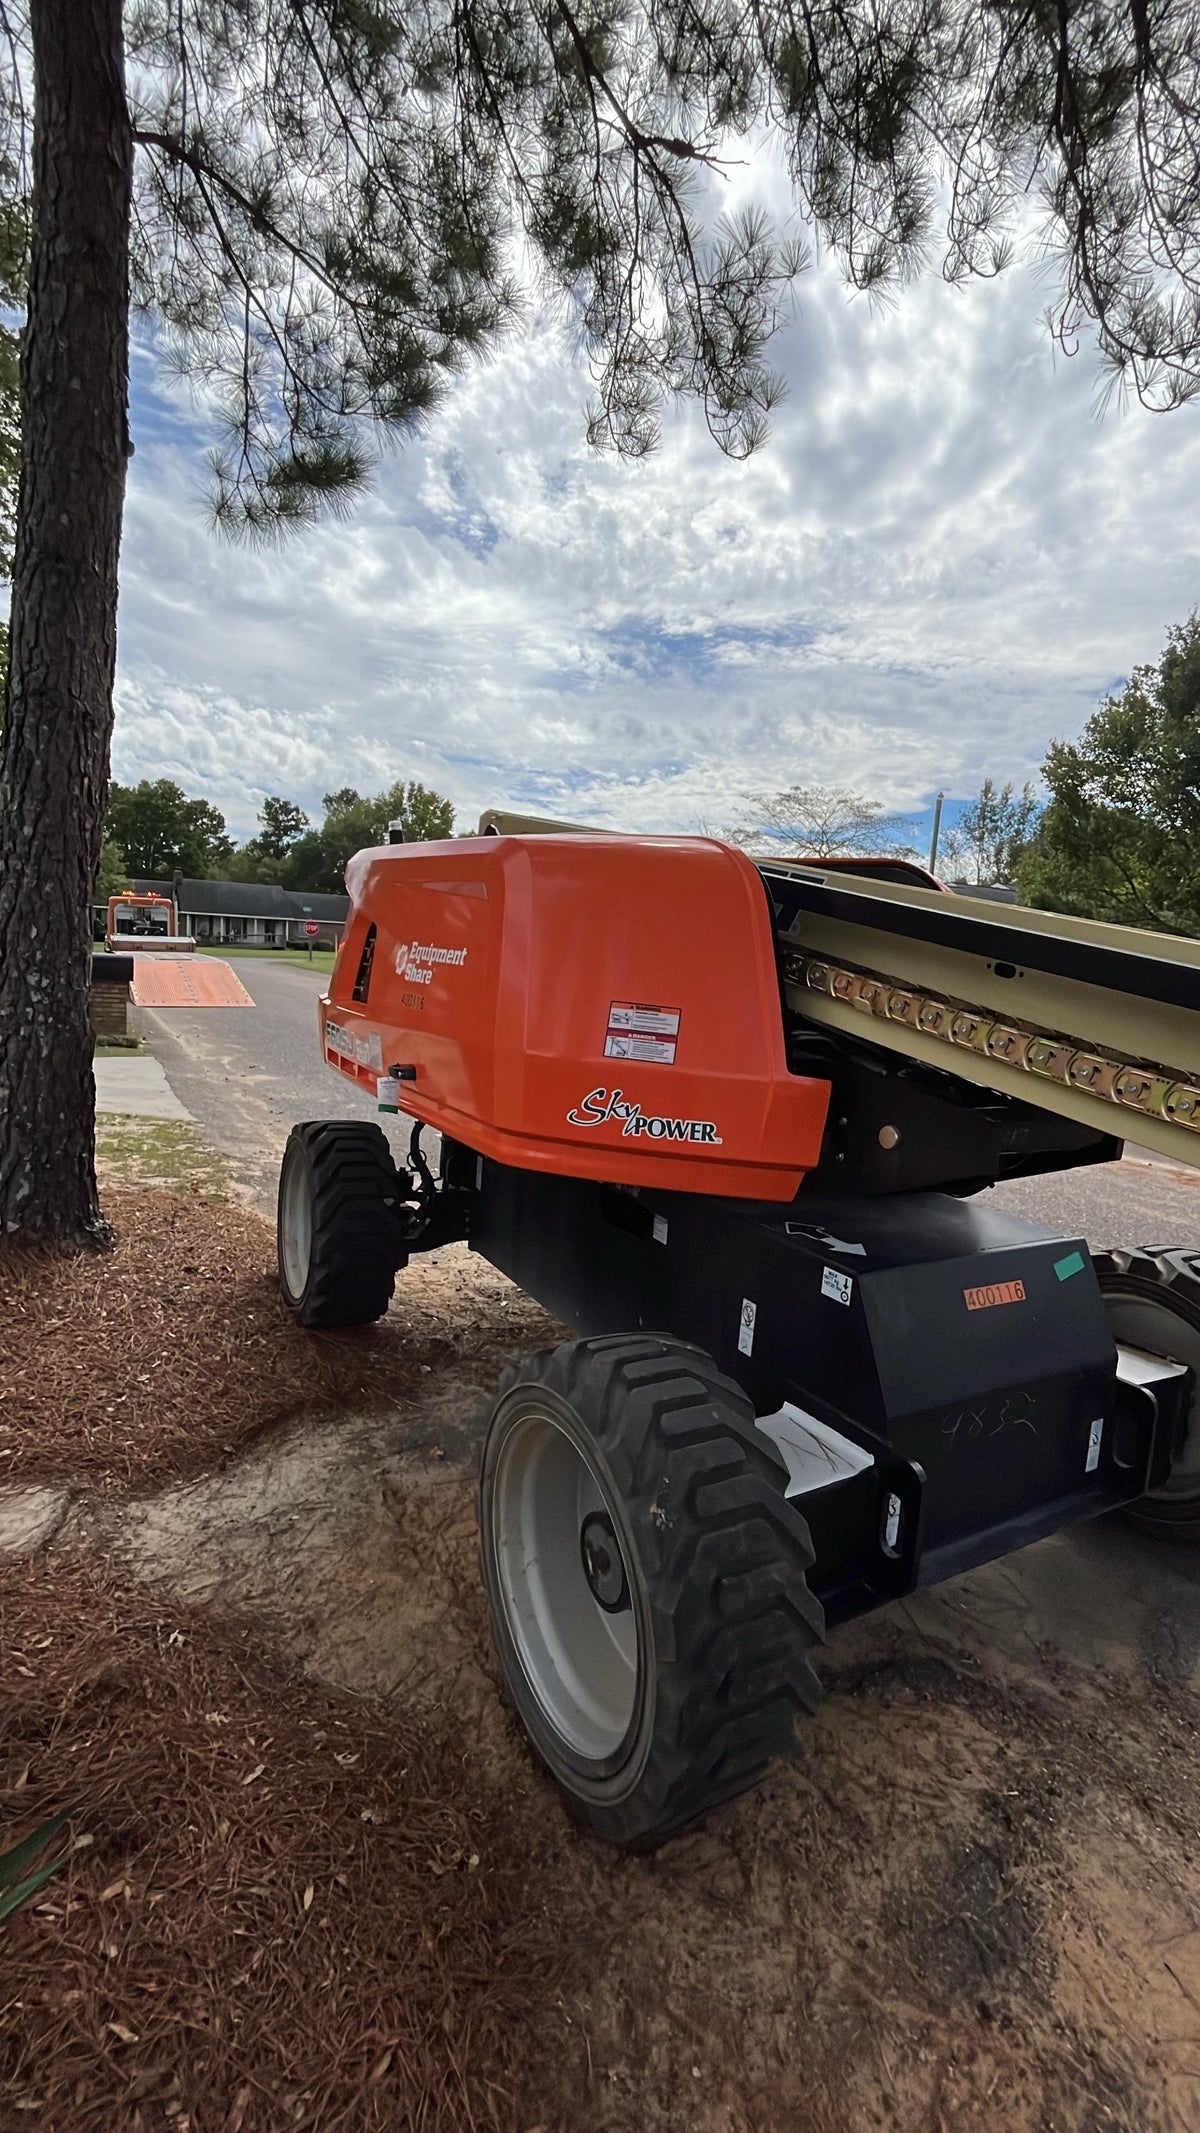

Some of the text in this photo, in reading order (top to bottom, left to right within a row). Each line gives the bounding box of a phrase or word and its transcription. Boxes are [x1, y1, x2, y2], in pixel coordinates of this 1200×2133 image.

[305, 924, 318, 932] STOP
[410, 941, 467, 966] Equipment
[404, 962, 432, 985] Share
[967, 1281, 1024, 1307] 400116
